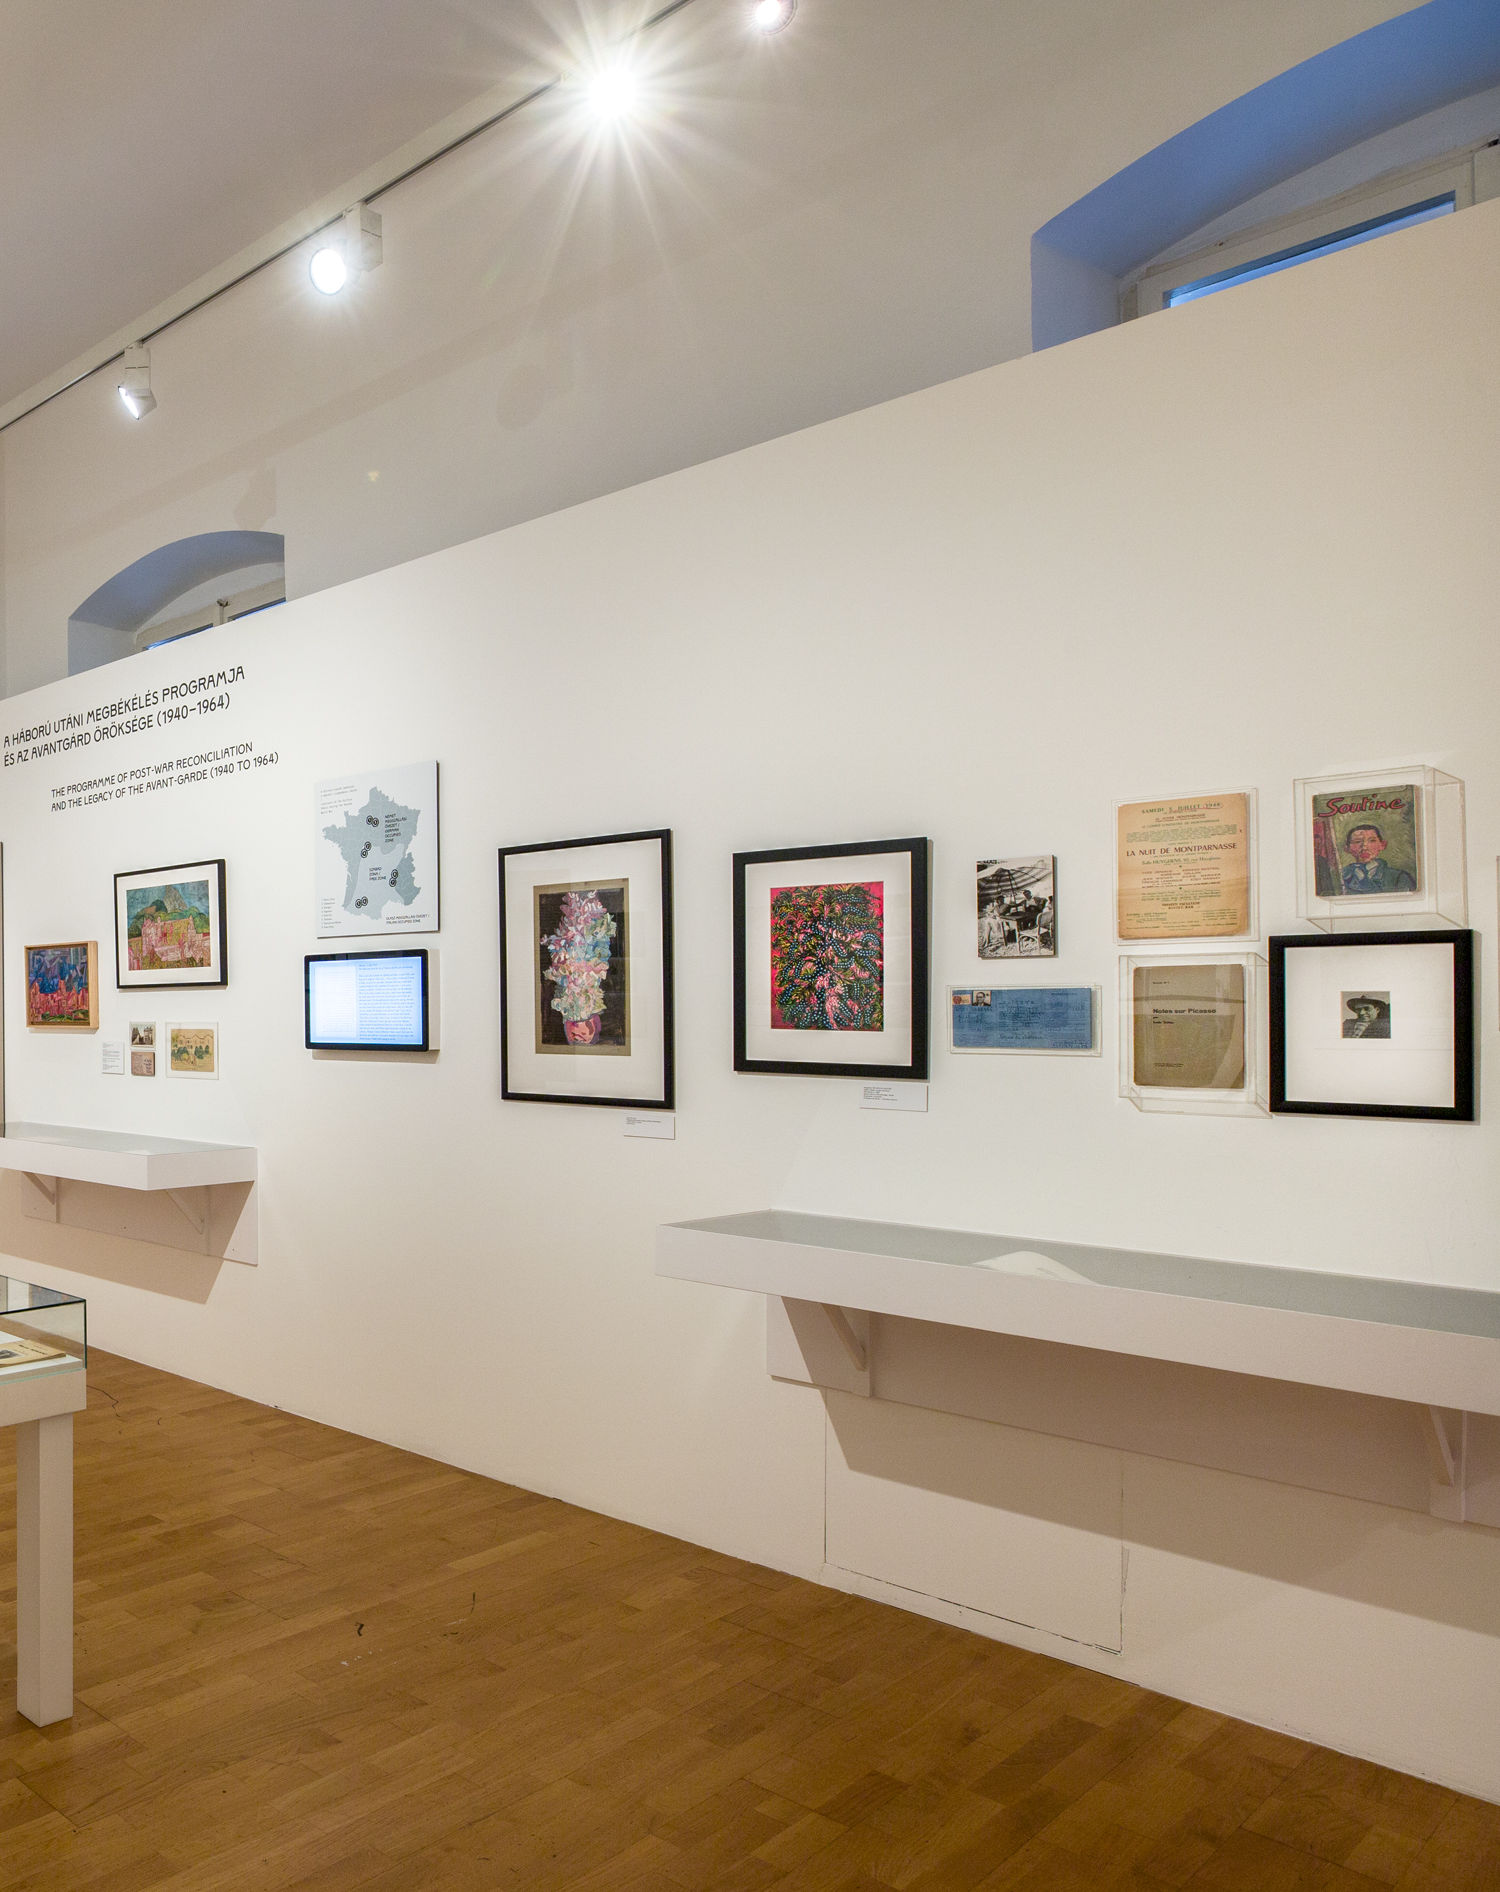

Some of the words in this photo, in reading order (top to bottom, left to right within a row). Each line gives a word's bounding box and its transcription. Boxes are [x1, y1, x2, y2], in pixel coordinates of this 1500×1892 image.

[4, 735, 10, 748] A
[12, 720, 51, 746] HÁBORÚ
[54, 714, 84, 734] UTÁNI
[86, 690, 158, 725] MEGBÉKÉLÉS
[162, 666, 245, 703] PROGRAMJA
[4, 752, 15, 767] ÉS
[16, 750, 28, 763] AZ
[31, 732, 90, 760] AVANTGÁRD
[94, 714, 153, 743] ÖRÖKSÉGE
[51, 786, 66, 798] THE
[67, 775, 115, 795] PROGRAMME
[117, 772, 128, 784] OF
[130, 761, 174, 781] POST-WAR
[176, 742, 253, 771] RECONCILIATION
[51, 801, 66, 812] AND
[68, 797, 82, 809] THE
[84, 790, 113, 806] LEGACY
[115, 787, 125, 798] OF
[128, 783, 144, 795] THE
[146, 769, 208, 792] AVANT-GARDE
[210, 762, 234, 779] (1940
[237, 760, 251, 772] TO
[253, 752, 279, 768] 1964)
[1318, 794, 1405, 817] Soutine
[1174, 843, 1237, 853] MONTPARNASSE
